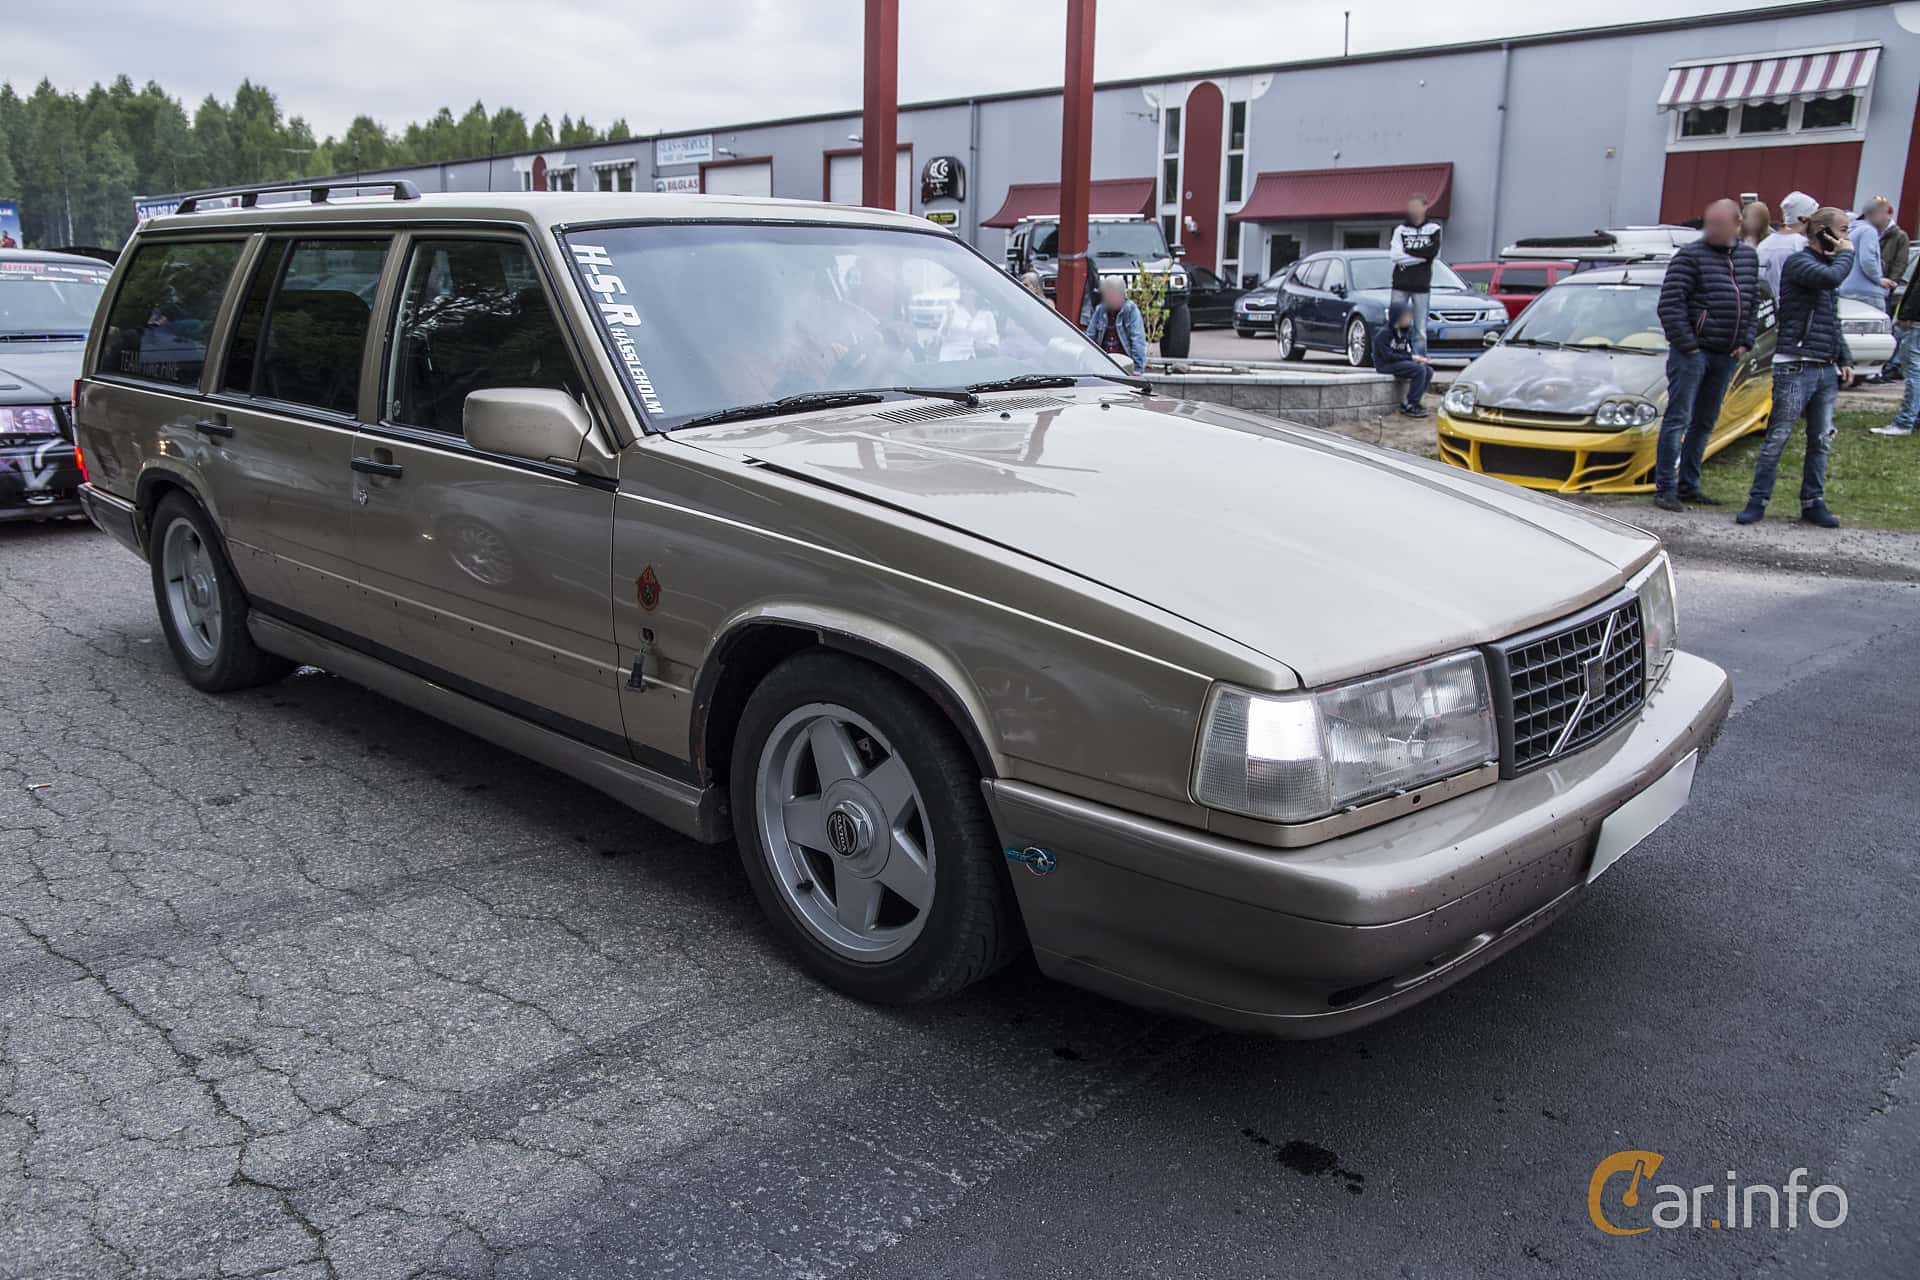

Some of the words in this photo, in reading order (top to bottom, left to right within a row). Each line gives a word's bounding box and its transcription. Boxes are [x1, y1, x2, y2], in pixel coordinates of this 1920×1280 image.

[667, 179, 698, 192] BILGLAS
[570, 244, 642, 326] H-S-R
[610, 327, 664, 414] HÄSSLEHOLM
[837, 815, 847, 851] VOLVO
